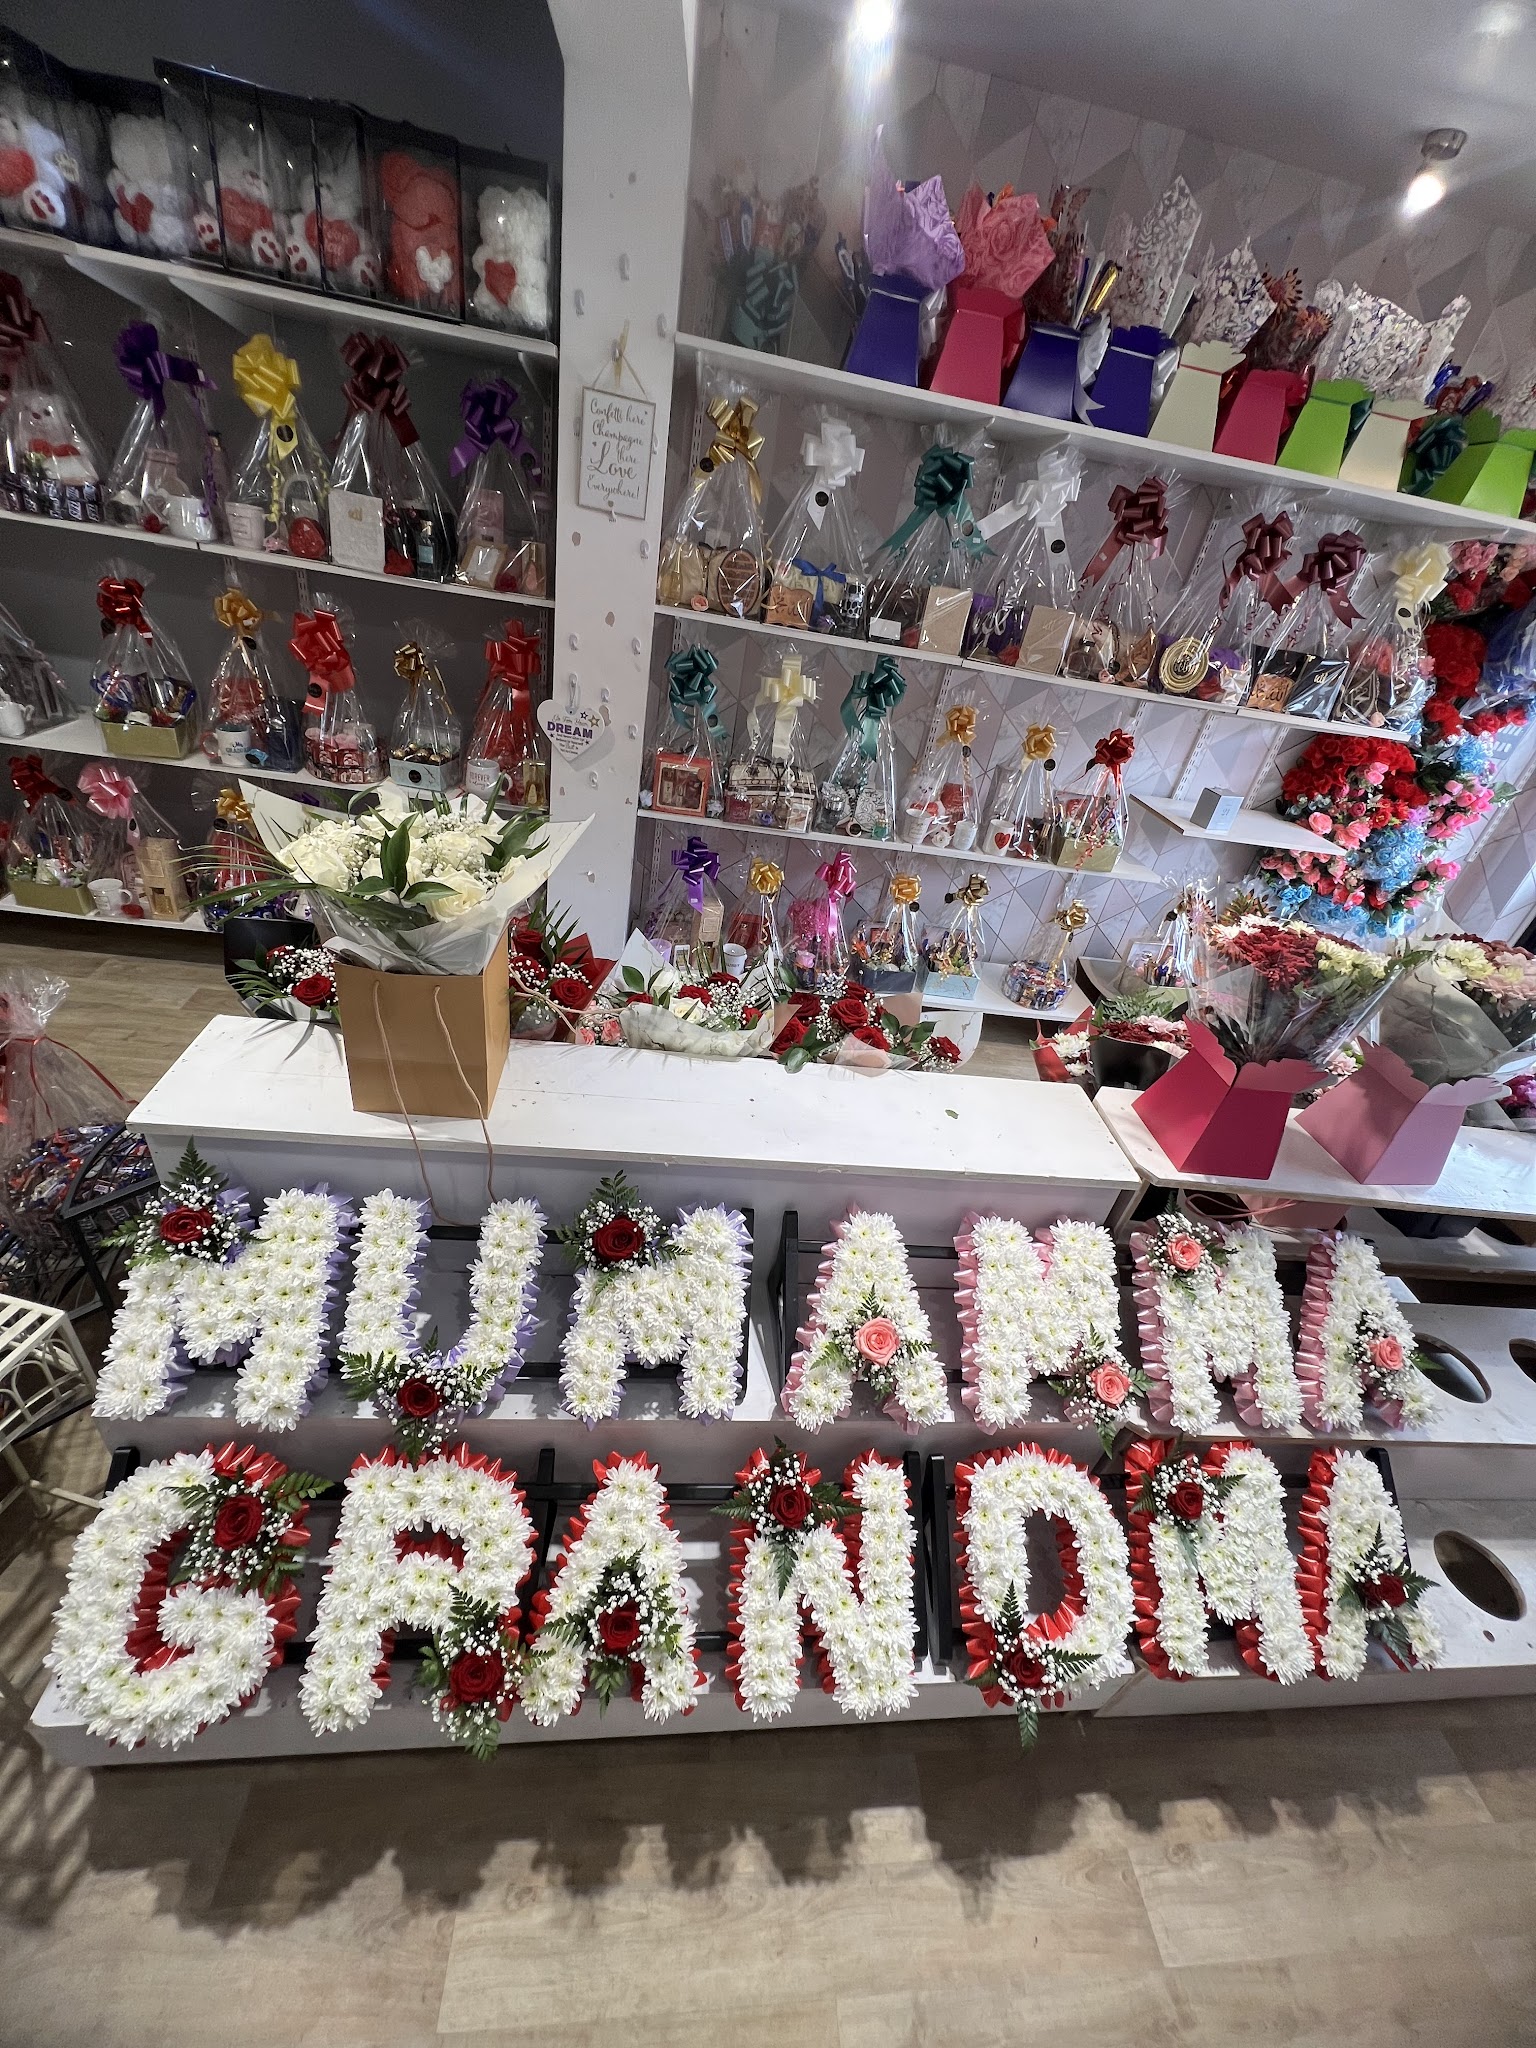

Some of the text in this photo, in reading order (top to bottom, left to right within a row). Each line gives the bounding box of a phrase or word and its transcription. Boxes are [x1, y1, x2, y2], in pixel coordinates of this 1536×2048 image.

[590, 397, 646, 426] Confetti here
[592, 418, 644, 451] Champagne
[586, 441, 638, 480] Love
[547, 721, 593, 739] DREAM
[92, 1182, 752, 1432] MUM
[42, 1443, 1446, 1750] GRANDMA
